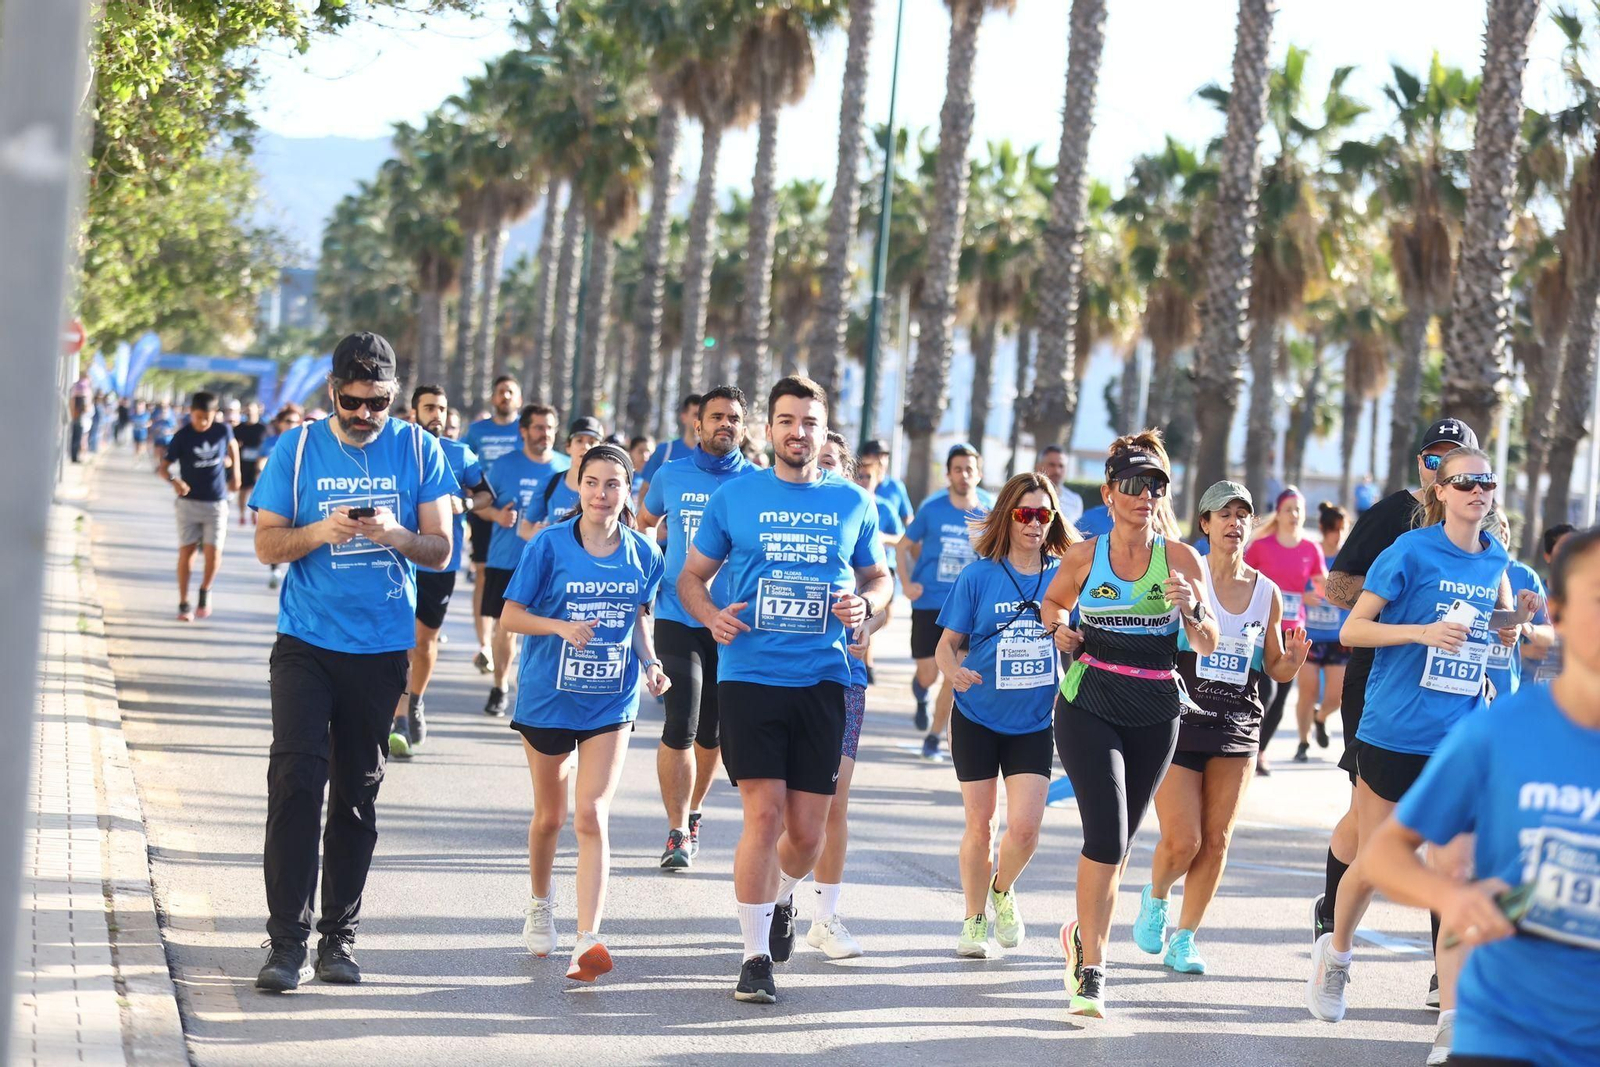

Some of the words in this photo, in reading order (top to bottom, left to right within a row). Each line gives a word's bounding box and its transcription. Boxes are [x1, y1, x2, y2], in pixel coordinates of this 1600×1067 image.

[317, 475, 397, 494] mayoral
[760, 511, 838, 527] mayoral
[759, 533, 833, 545] RUNNING
[766, 543, 828, 554] MAKES
[765, 552, 828, 564] FRIENDS
[566, 579, 639, 597] mayoral
[565, 601, 634, 613] RUNNING
[766, 599, 820, 617] 1778
[571, 610, 626, 621] MAKES
[1084, 614, 1171, 627] TORREMOLINOS
[569, 660, 618, 678] 1857
[1010, 660, 1045, 675] 863
[1209, 654, 1239, 670] 988
[1435, 659, 1479, 680] 1167
